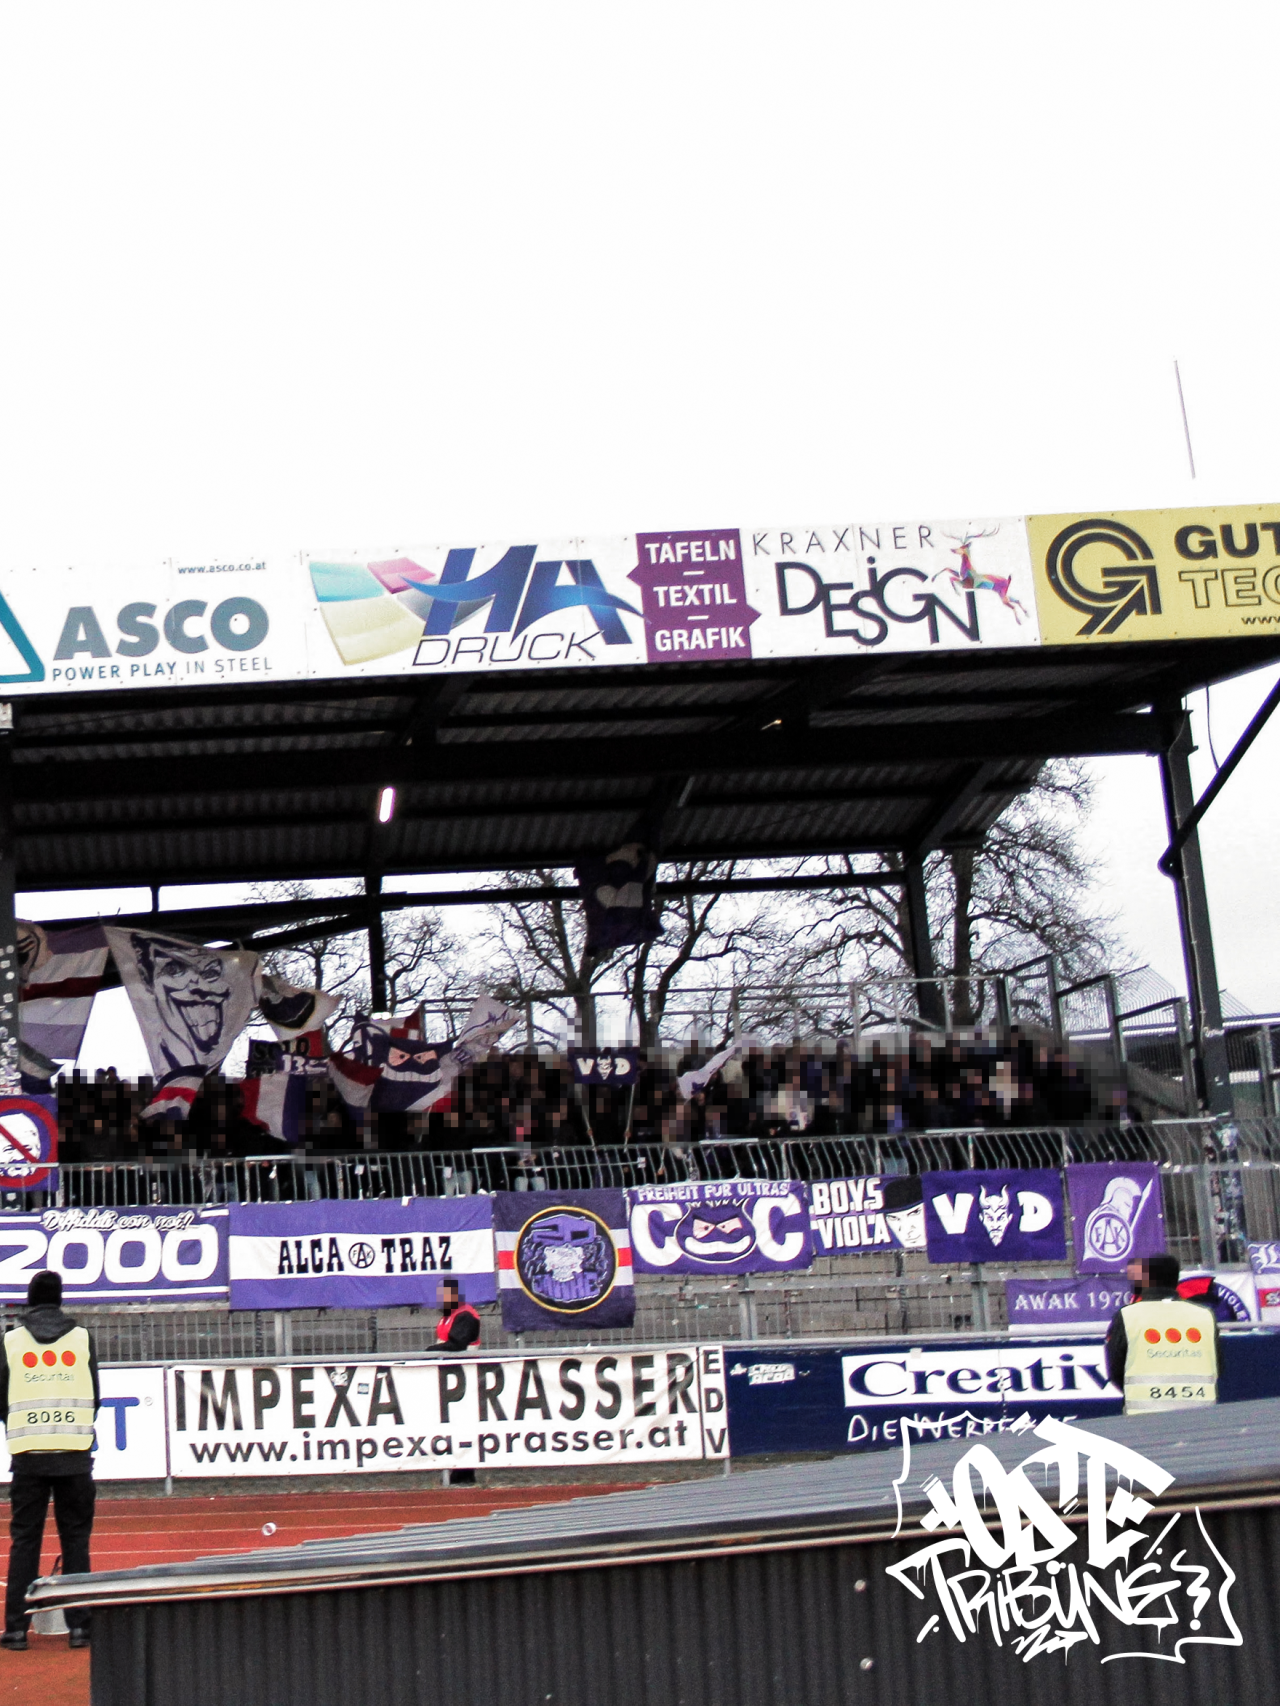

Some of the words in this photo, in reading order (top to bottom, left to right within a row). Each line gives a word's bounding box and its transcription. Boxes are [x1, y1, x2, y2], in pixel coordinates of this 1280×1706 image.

[645, 540, 736, 564] TAFELN
[752, 525, 935, 557] KRAXNER
[178, 561, 267, 574] www.asco.co.at
[653, 583, 737, 608] TEXTIL
[53, 596, 269, 661] ASCO
[654, 627, 745, 654] GRAFIK
[412, 629, 605, 667] DRUCK
[52, 664, 121, 681] POWER
[130, 662, 177, 679] PLAY
[186, 660, 205, 675] IN
[215, 657, 273, 673] STEEL
[637, 1186, 699, 1201] FREIHEIT
[812, 1177, 885, 1216] BOYS
[41, 1208, 118, 1232] Diffidati
[814, 1212, 892, 1249] VIOLA
[278, 1237, 344, 1275] ALCA
[381, 1235, 453, 1274] TRAZ
[1014, 1291, 1080, 1310] AWAK
[175, 1365, 405, 1432] IMPEXA
[438, 1353, 701, 1425] PRASSER
[1150, 1386, 1206, 1399] 8454
[27, 1411, 76, 1424] 8086
[189, 1418, 688, 1468] www.impexa-prasser.at
